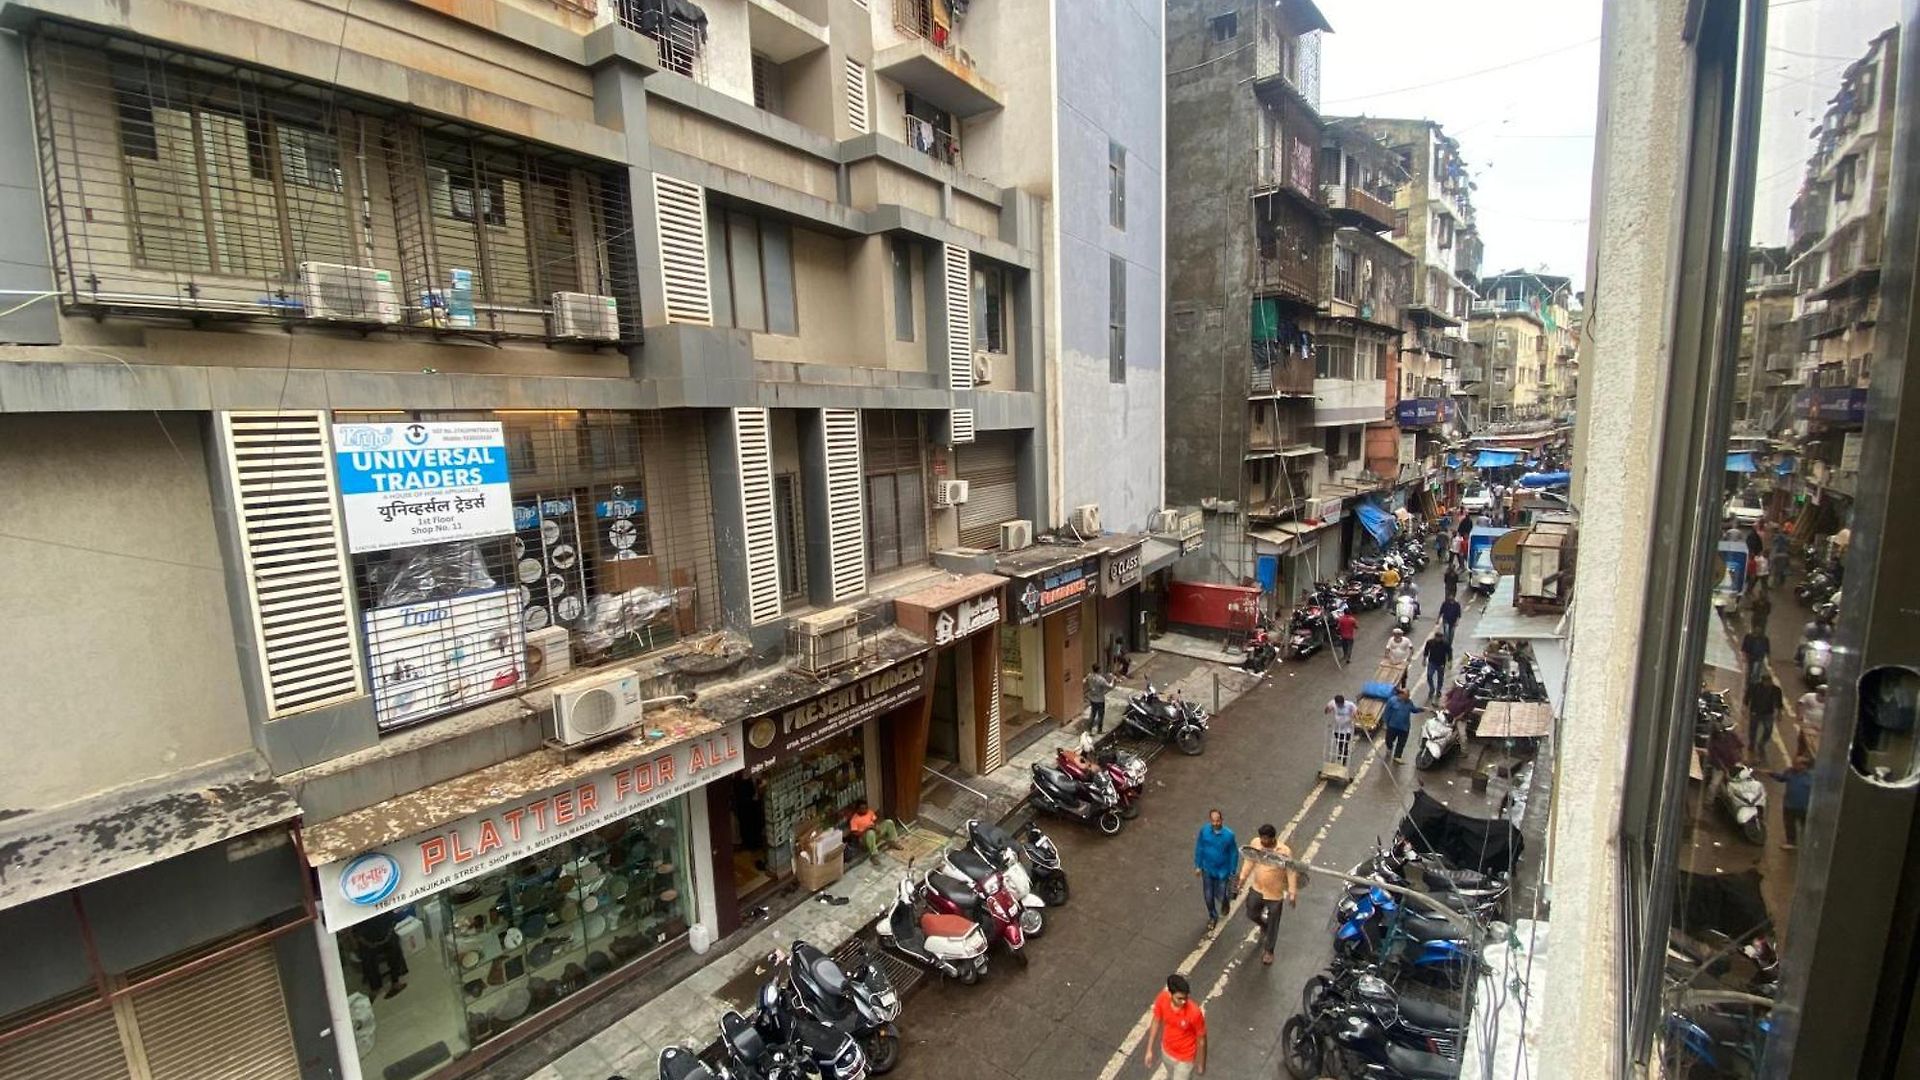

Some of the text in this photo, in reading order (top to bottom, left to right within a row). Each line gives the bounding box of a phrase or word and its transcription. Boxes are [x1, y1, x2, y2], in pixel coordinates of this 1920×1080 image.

[352, 447, 495, 471] UNIVERSAL
[371, 468, 483, 492] TRADERS
[378, 493, 486, 522] युनिव्हर्सल ट्रेडर्स
[418, 515, 455, 526] 1st Floor
[411, 522, 463, 536] Shop No. 11
[783, 684, 859, 734] PRESENT
[860, 658, 924, 699] TRADERS
[421, 783, 599, 875] PLATTER
[615, 754, 675, 801] FOR
[689, 732, 739, 775] ALL
[409, 876, 452, 898] JANJIKAR
[488, 853, 511, 867] SHOP
[535, 831, 568, 848] MUSTAFA
